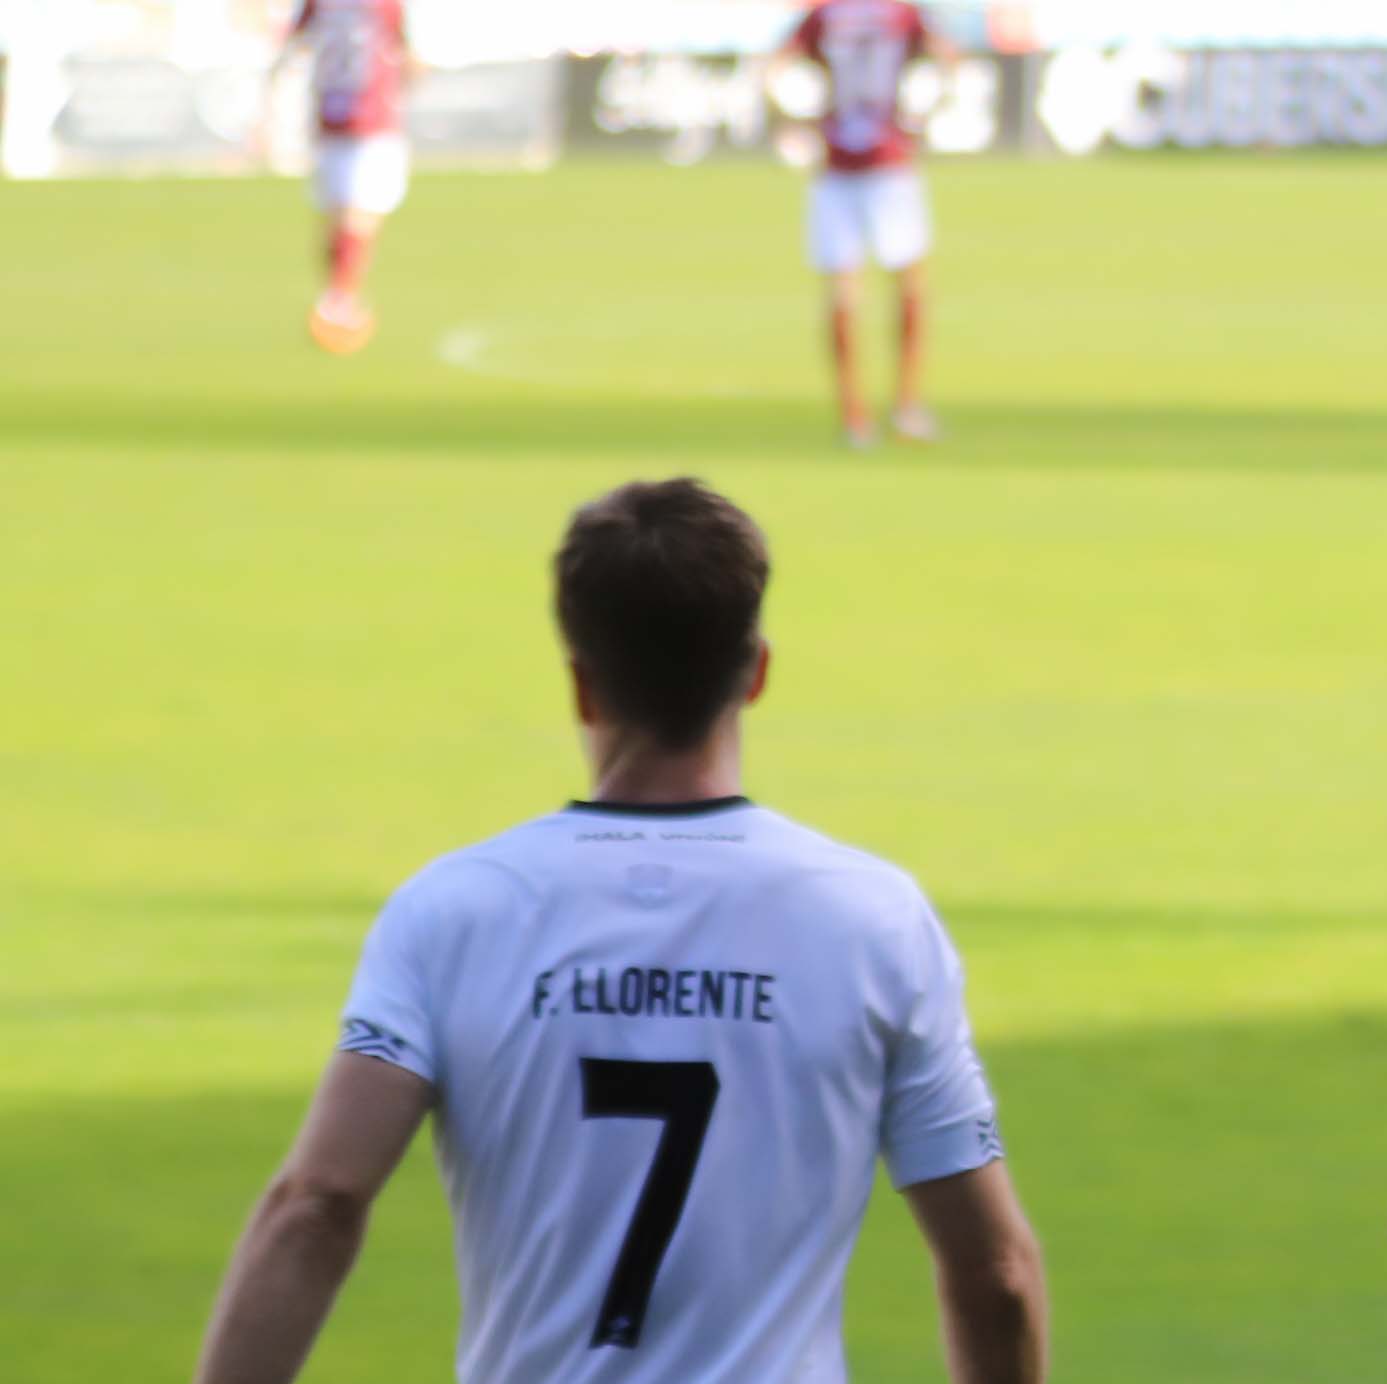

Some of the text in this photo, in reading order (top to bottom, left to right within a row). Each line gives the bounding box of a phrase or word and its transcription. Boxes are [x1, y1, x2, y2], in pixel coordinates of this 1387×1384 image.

[532, 966, 775, 1023] F. LLORENTE
[580, 1057, 720, 1349] 7
